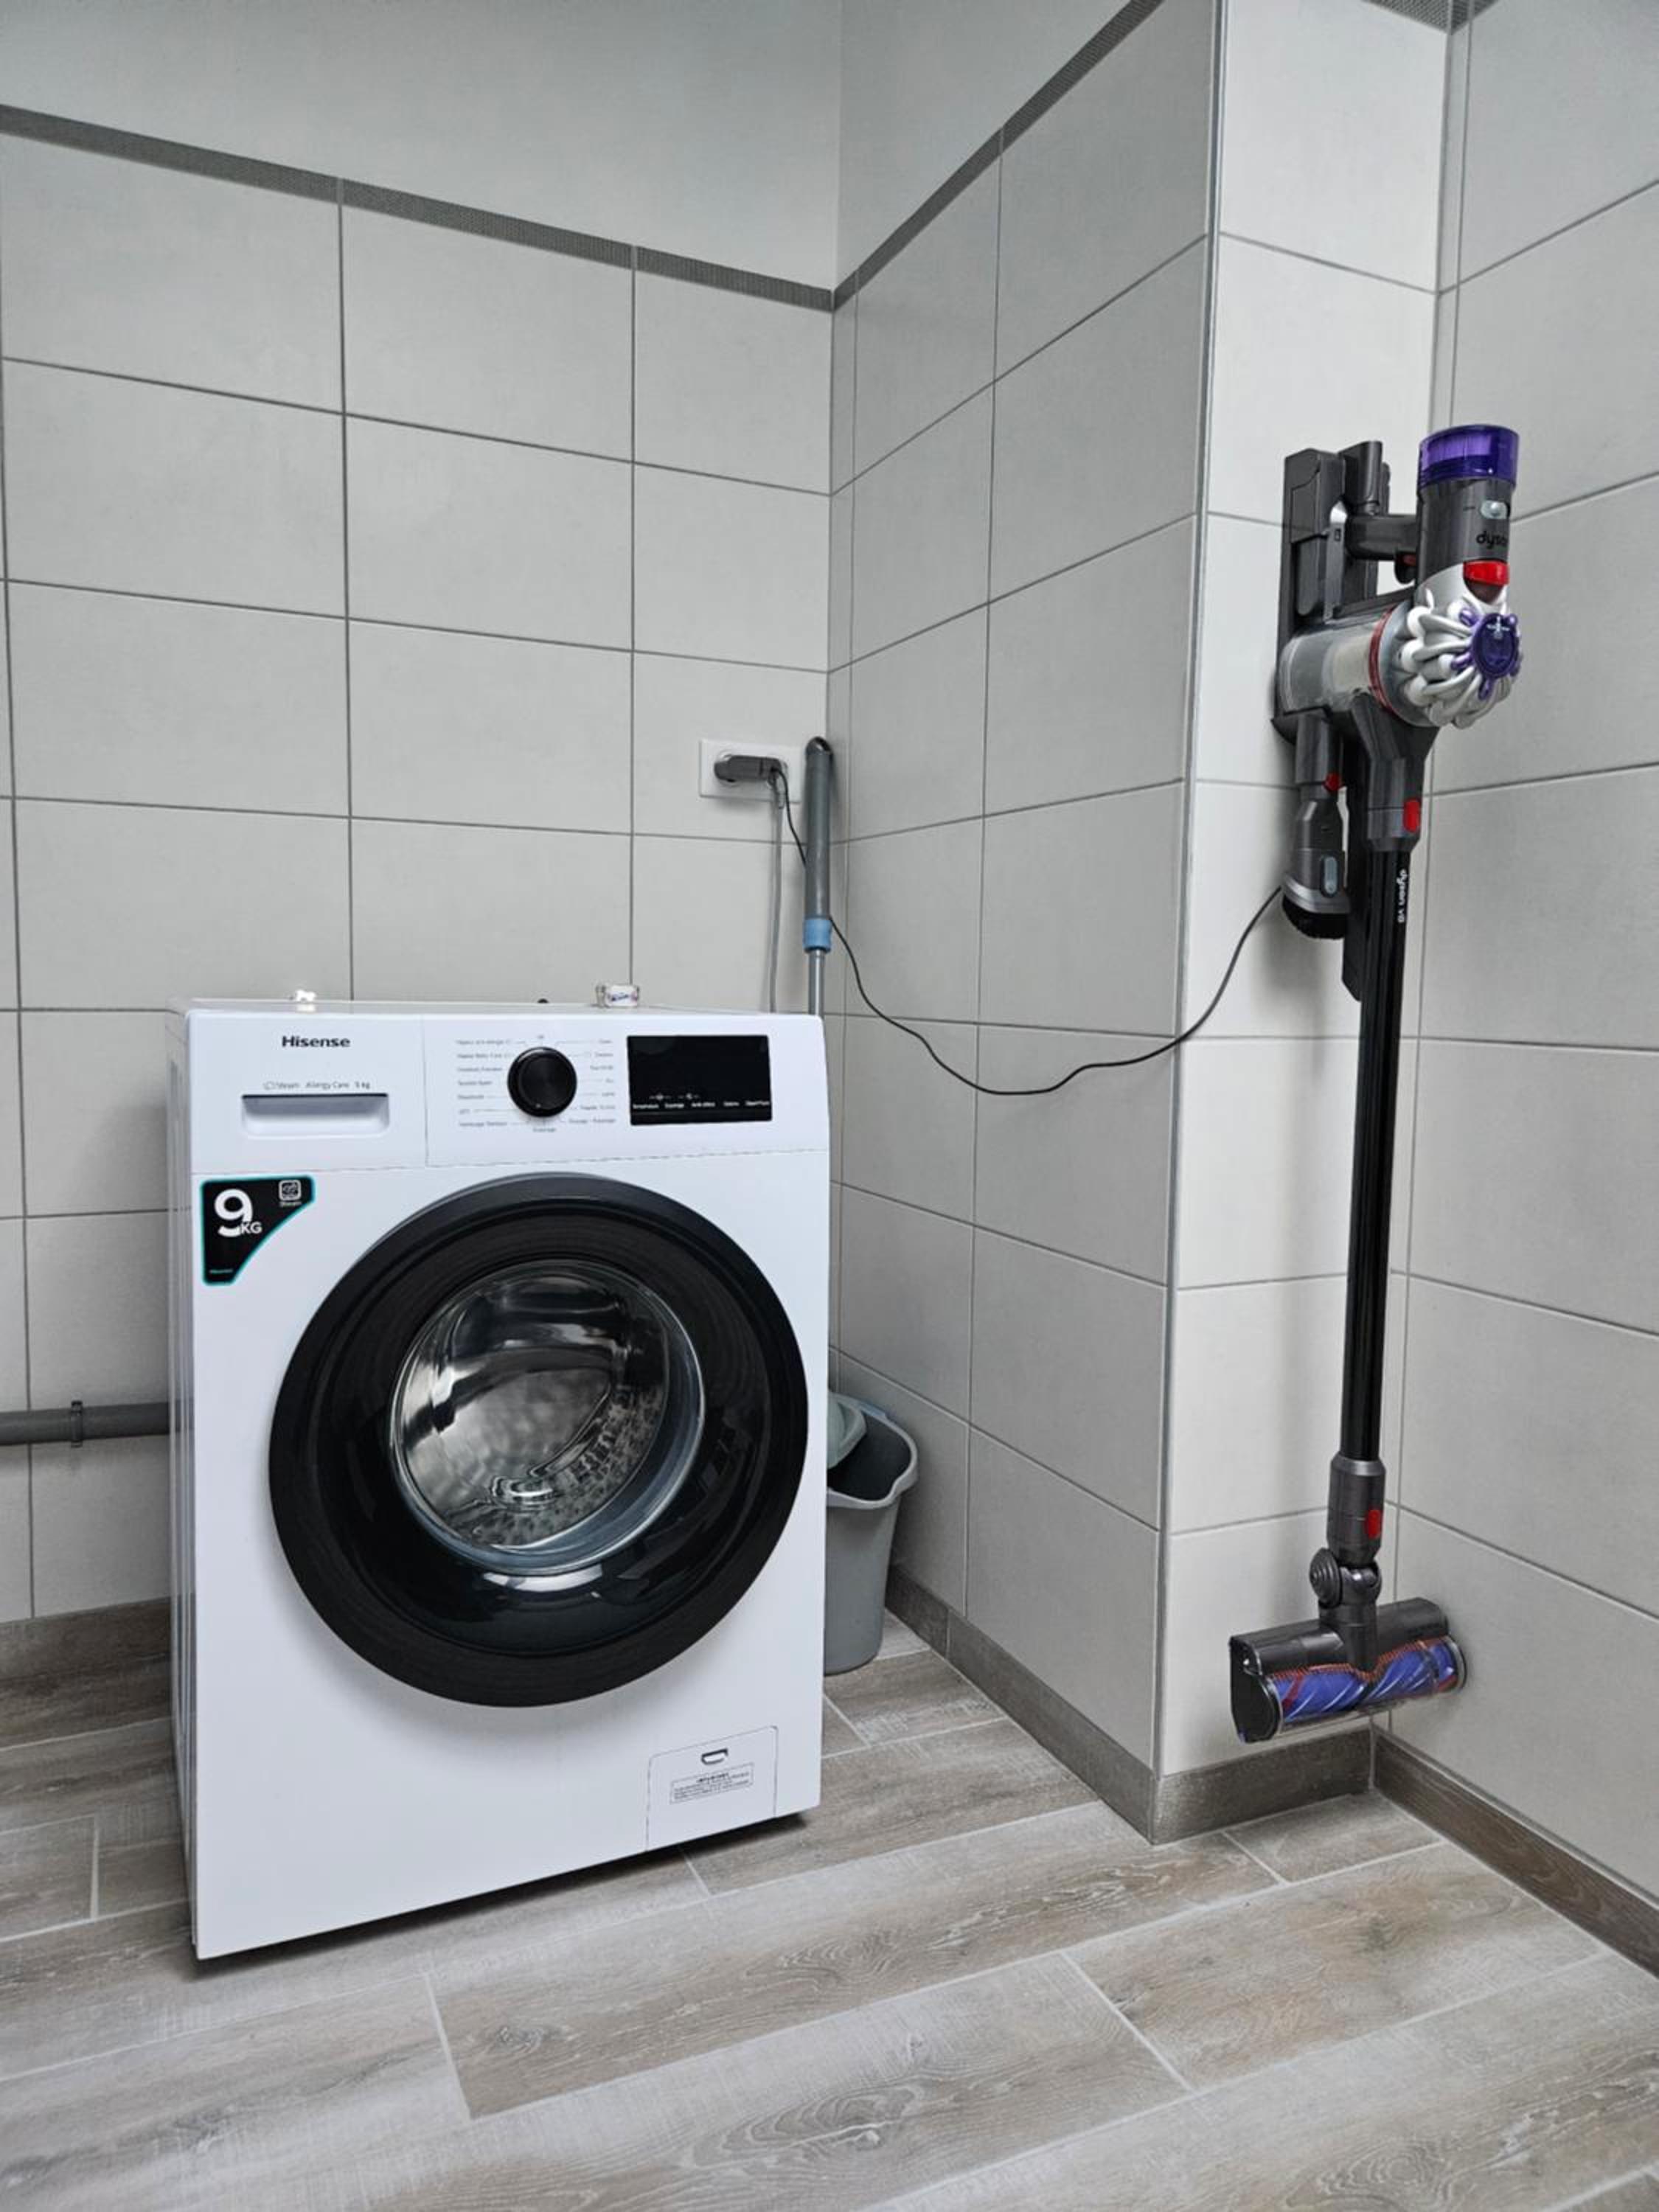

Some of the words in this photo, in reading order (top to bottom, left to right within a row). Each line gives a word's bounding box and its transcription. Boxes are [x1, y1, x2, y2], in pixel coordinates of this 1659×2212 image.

[1397, 869, 1408, 906] dyson
[281, 1035, 352, 1048] Hisense
[214, 1189, 253, 1237] 9
[240, 1222, 262, 1234] KG
